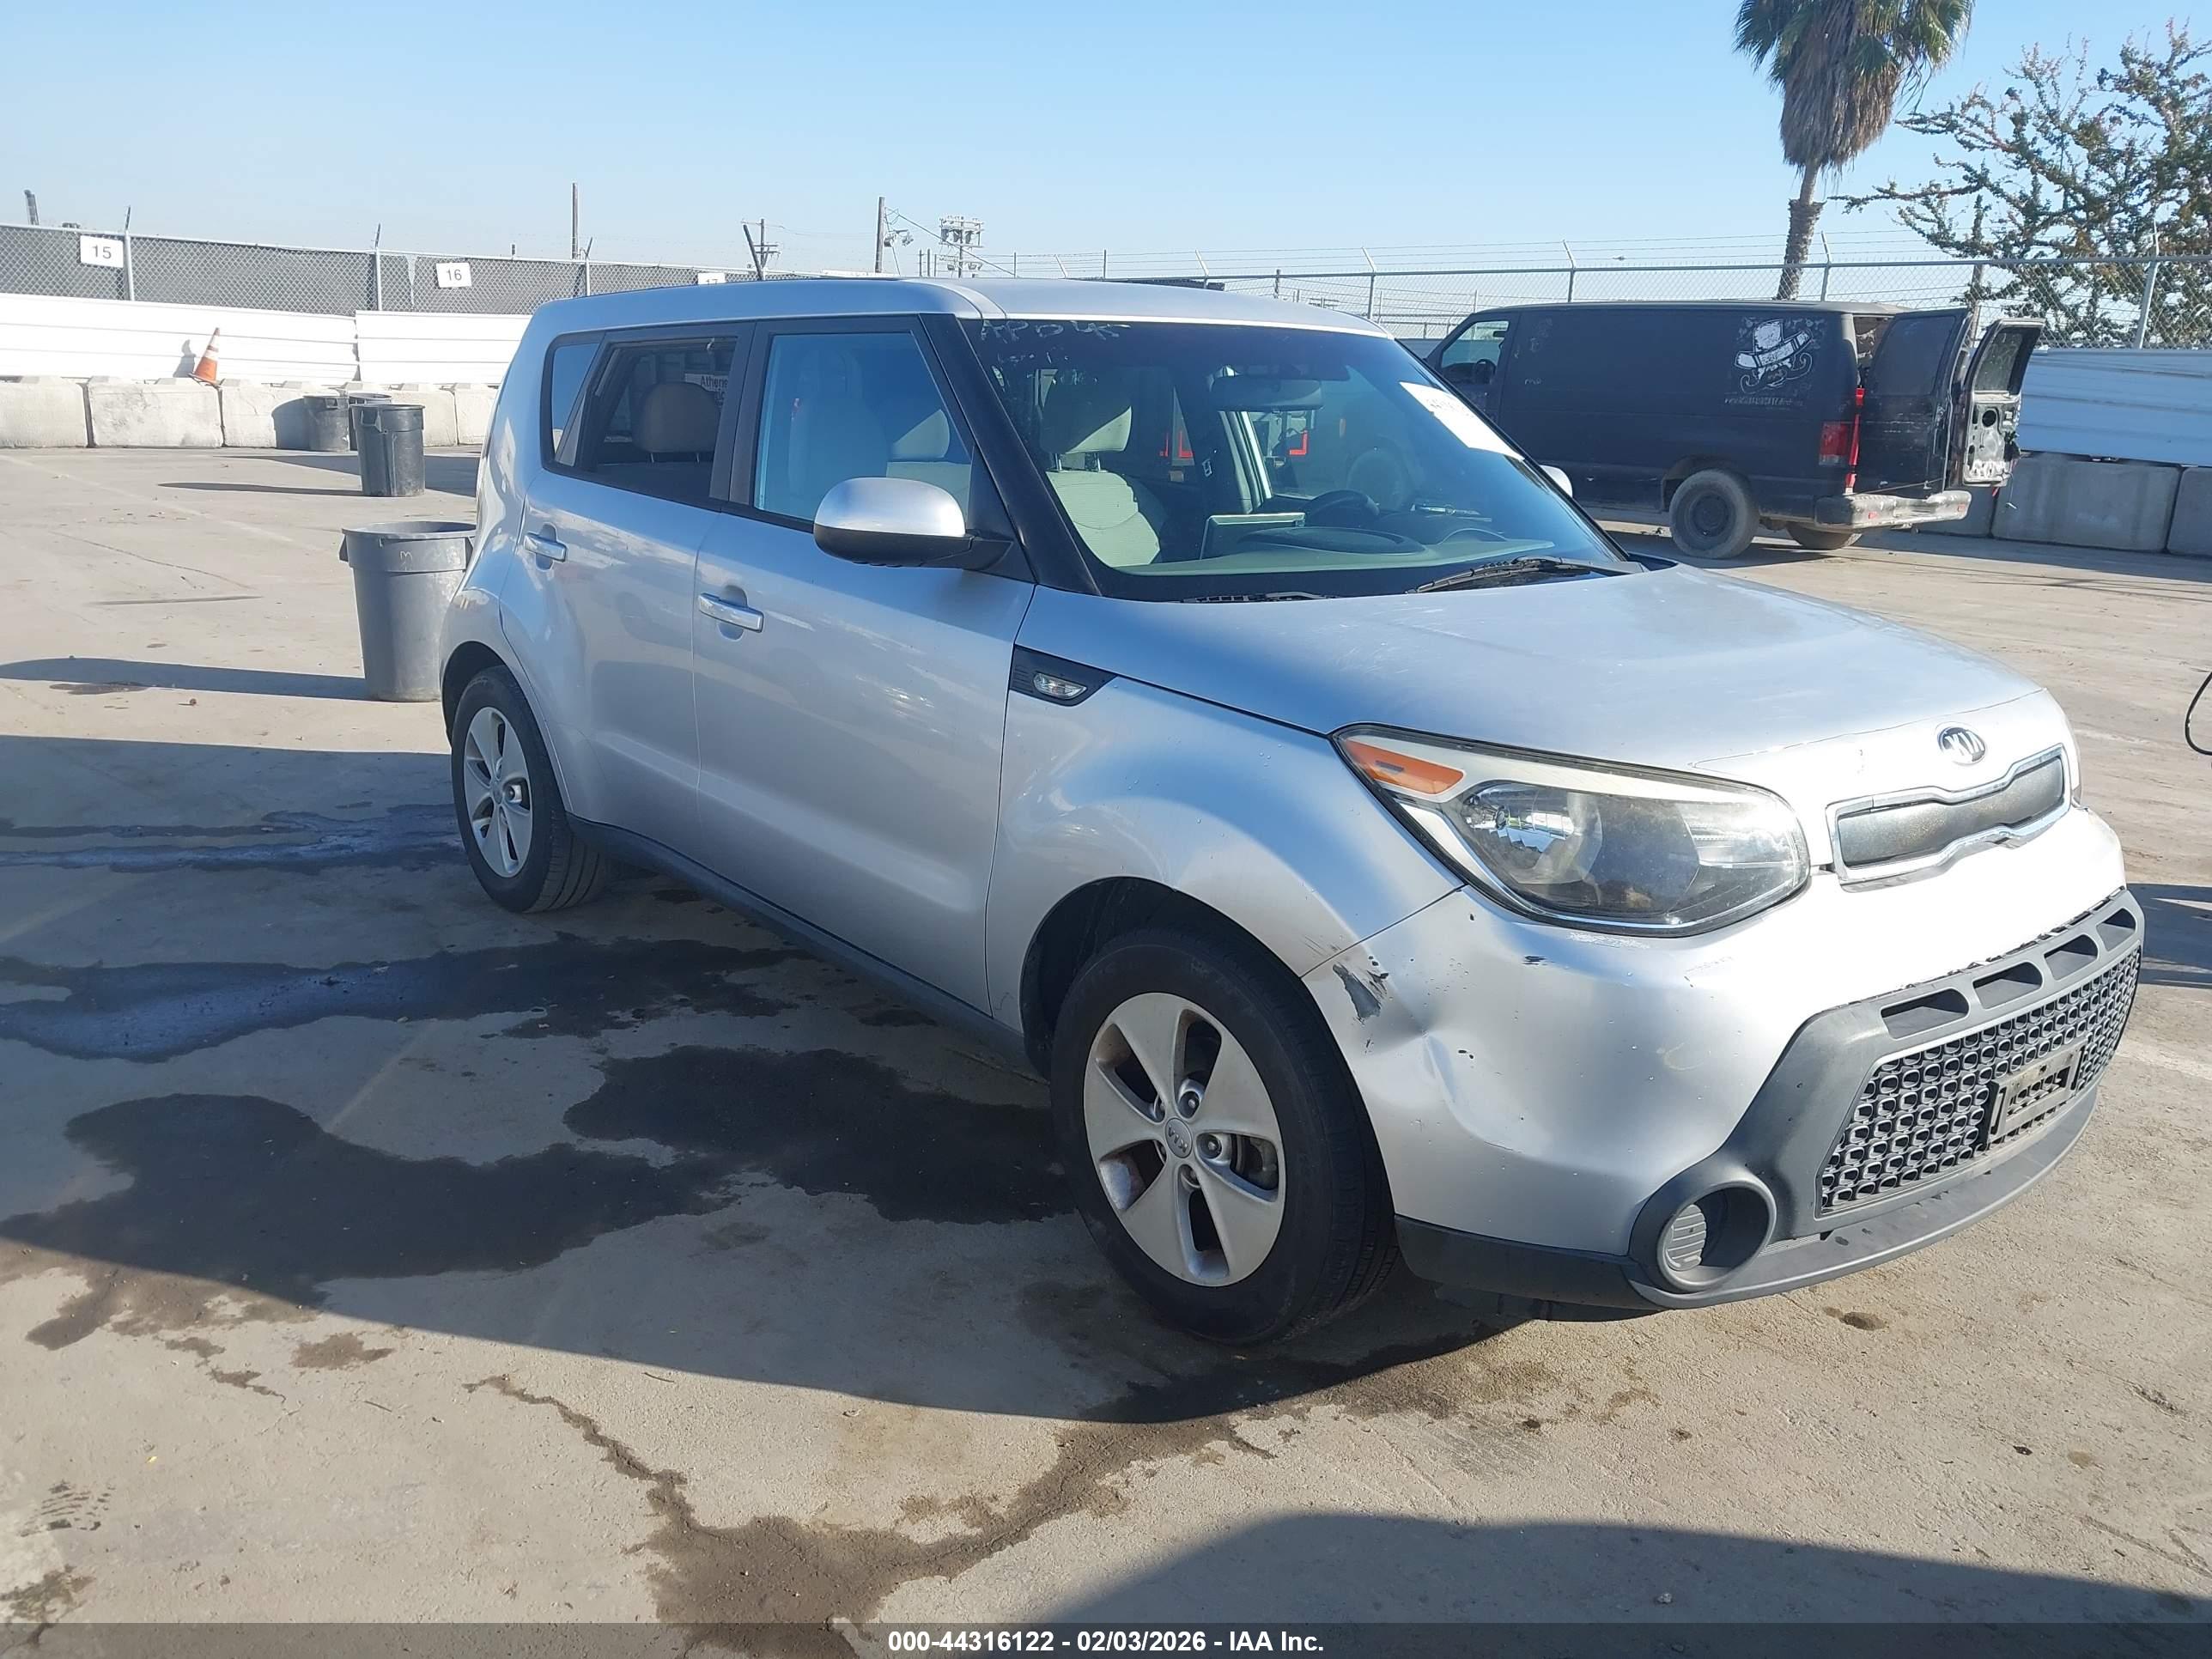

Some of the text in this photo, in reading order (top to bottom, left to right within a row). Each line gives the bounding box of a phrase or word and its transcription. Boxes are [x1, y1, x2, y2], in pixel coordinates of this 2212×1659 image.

[92, 244, 112, 259] 15
[447, 268, 462, 281] 16
[1167, 1124, 1188, 1153] KIA
